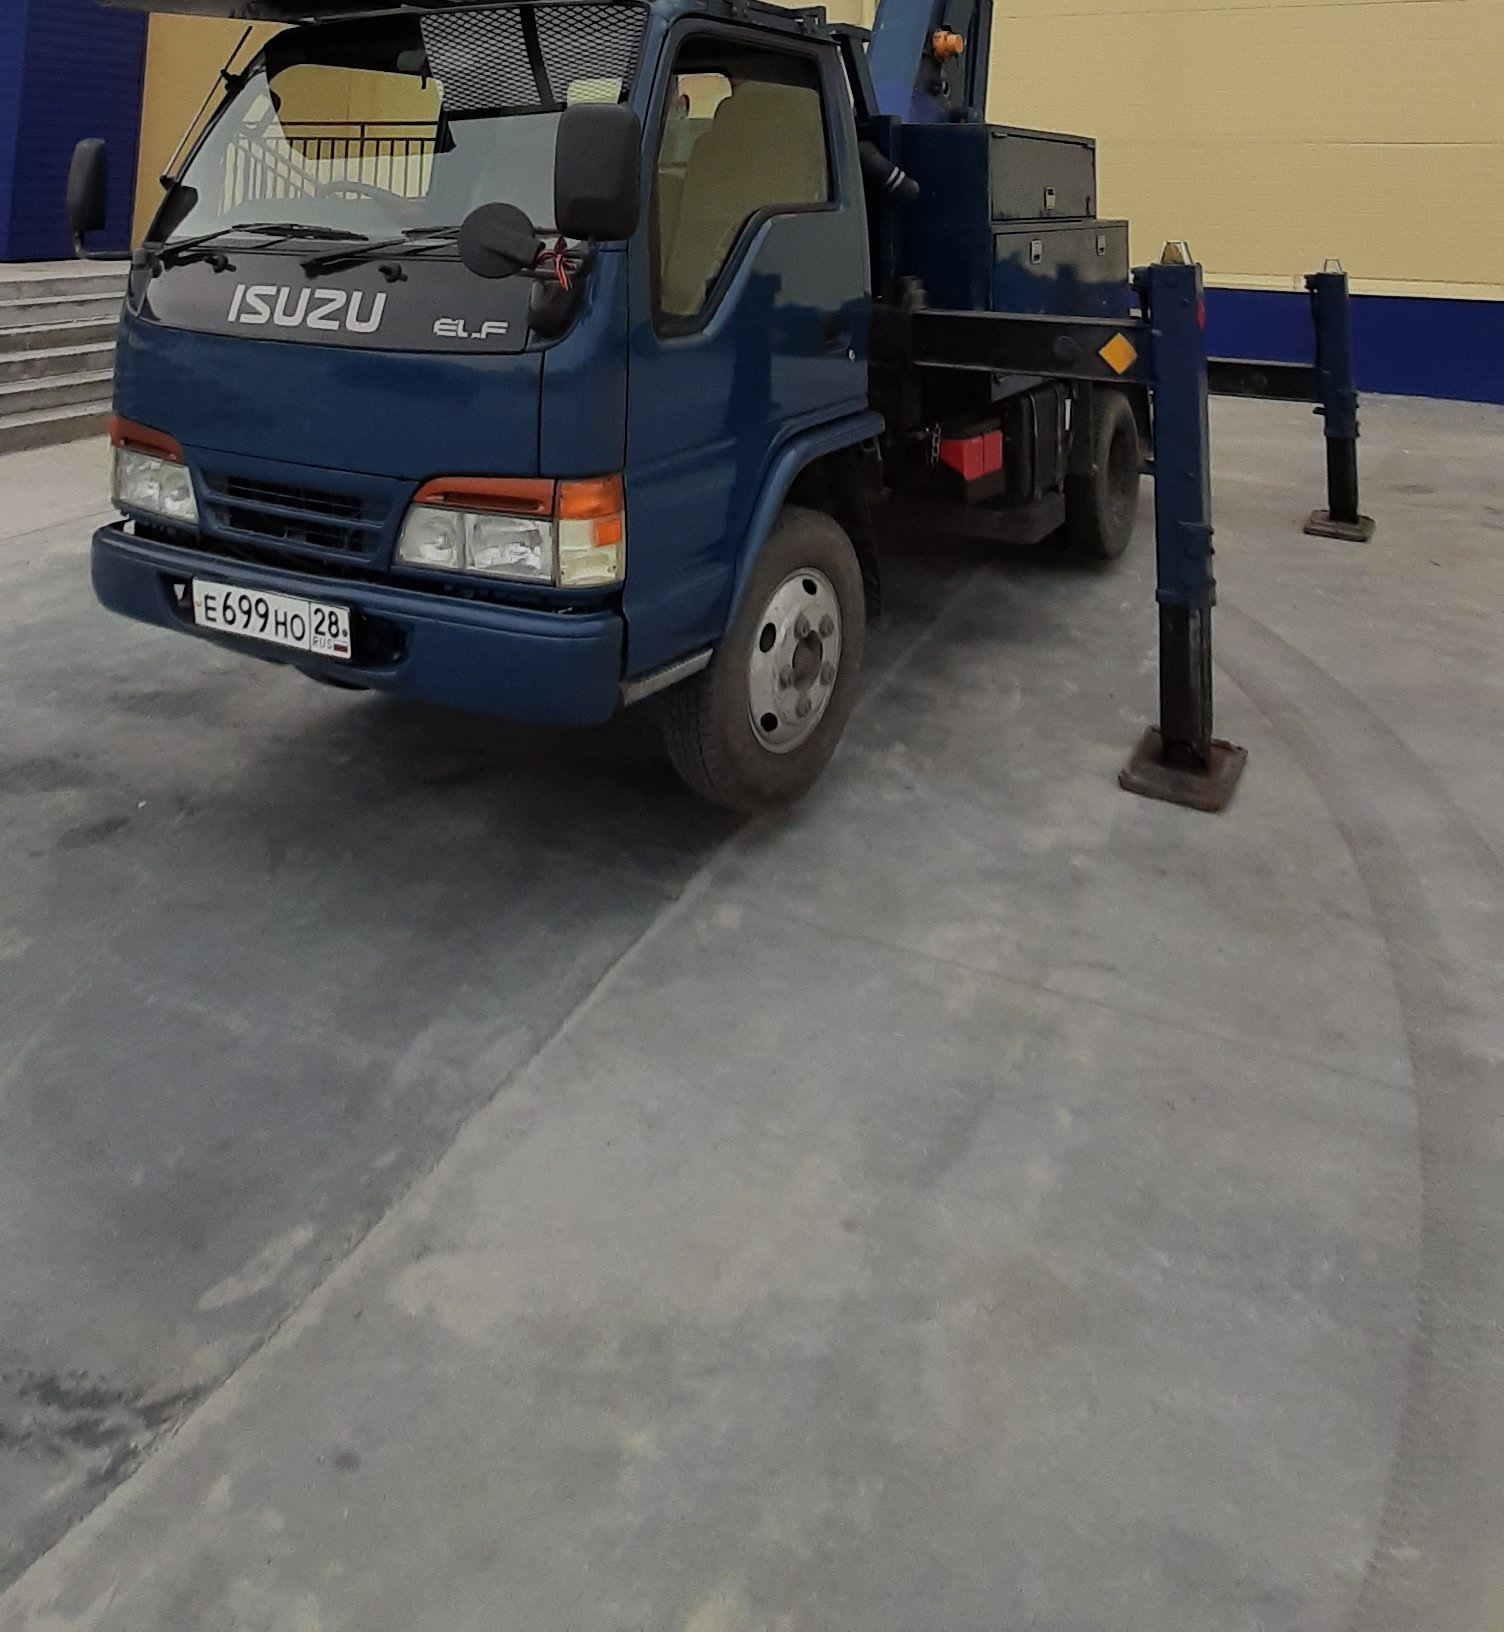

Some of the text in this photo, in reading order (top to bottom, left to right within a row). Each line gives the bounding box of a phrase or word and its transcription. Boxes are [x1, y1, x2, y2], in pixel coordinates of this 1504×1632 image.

[227, 284, 508, 339] ISUZU ELF
[313, 608, 340, 639] 28
[312, 636, 333, 650] RUS
